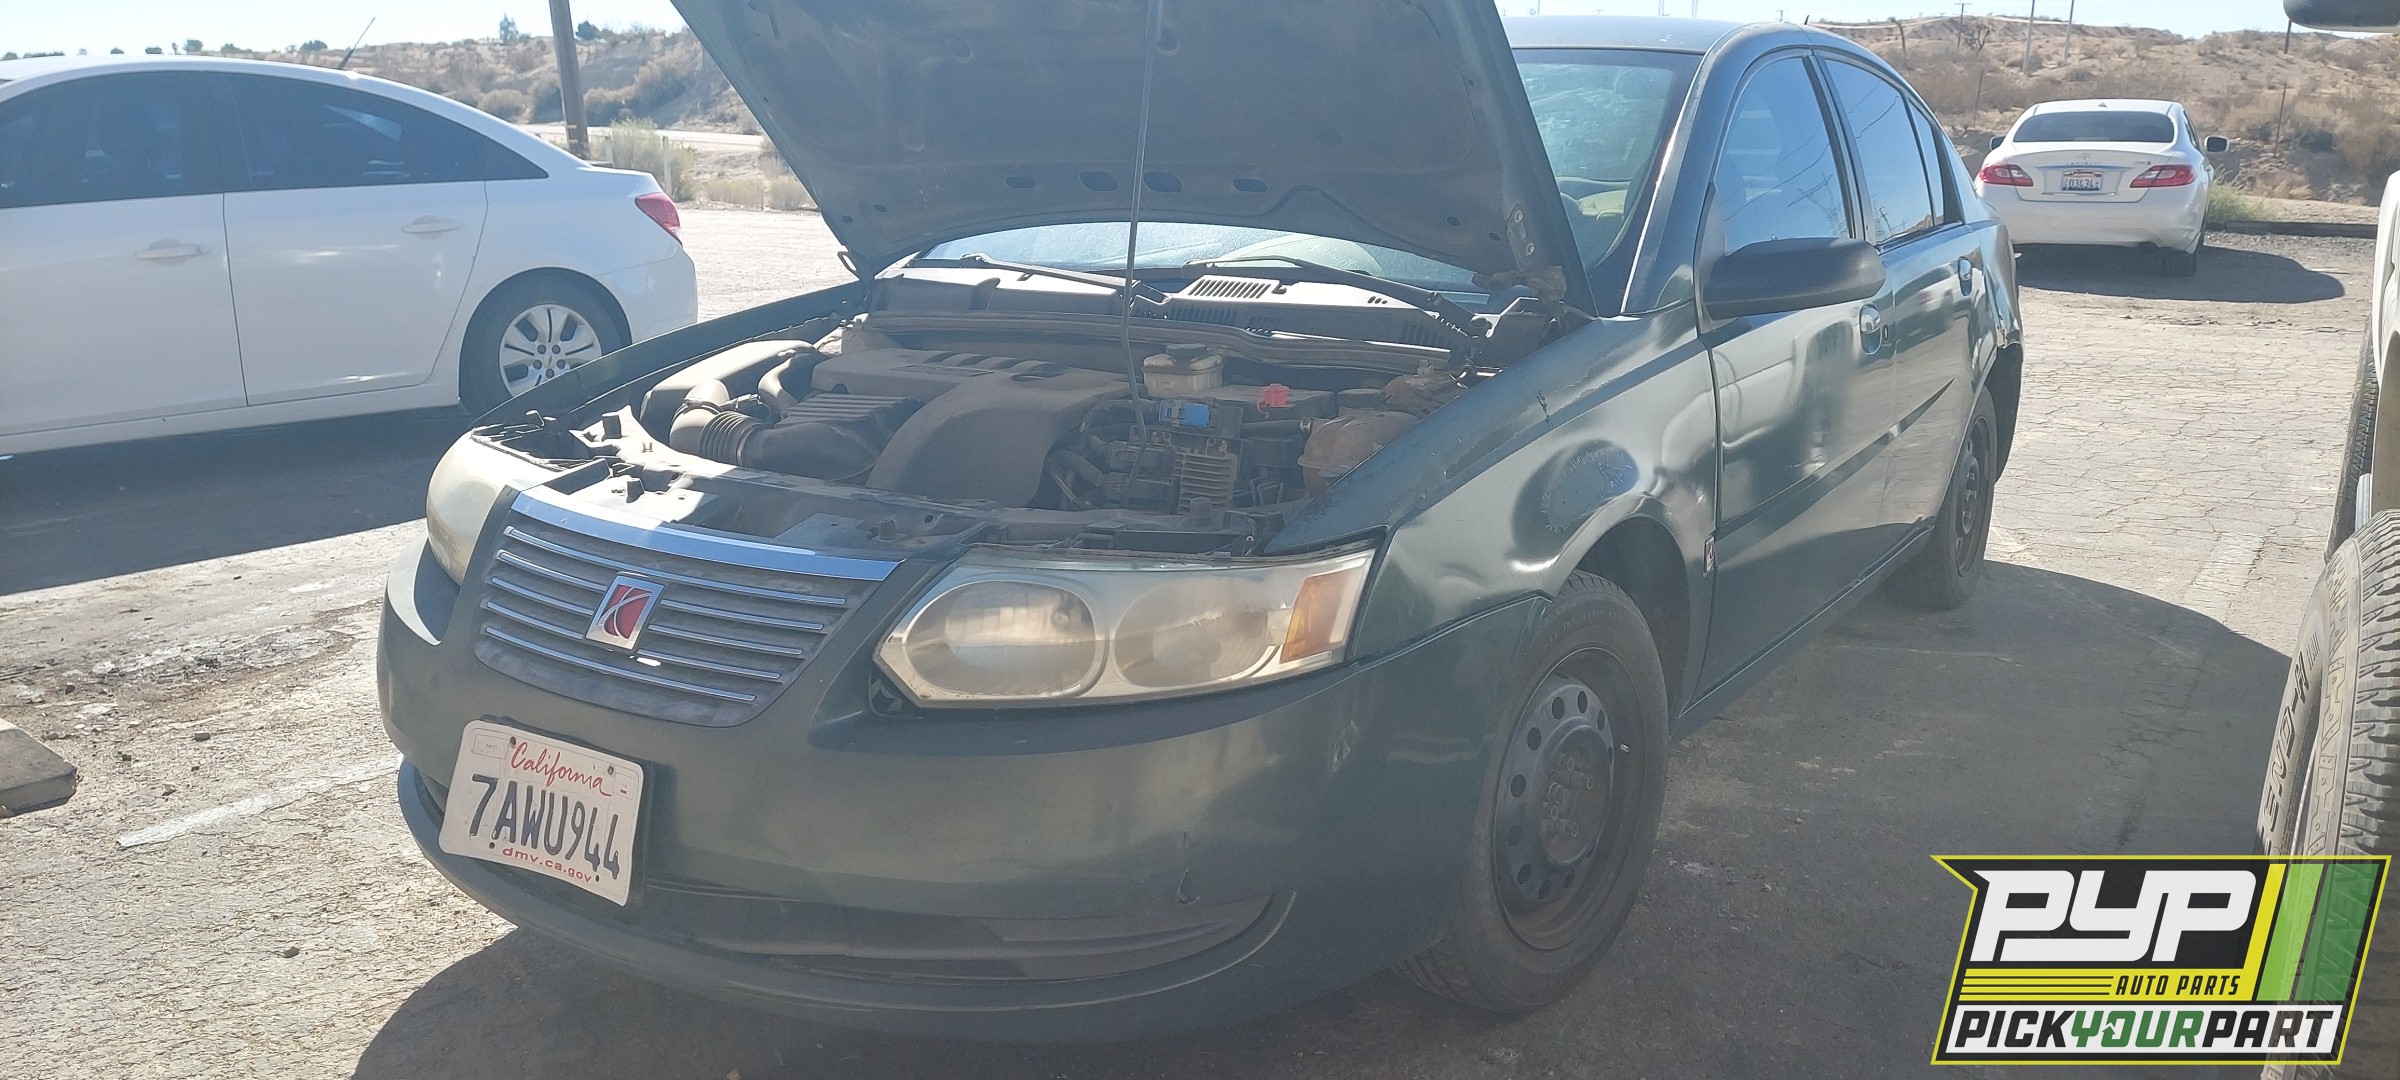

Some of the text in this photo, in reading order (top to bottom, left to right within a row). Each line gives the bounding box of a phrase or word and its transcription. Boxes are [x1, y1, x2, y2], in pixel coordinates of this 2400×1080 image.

[511, 741, 612, 797] California
[468, 773, 620, 880] 7AWU944
[502, 847, 592, 883] dmv.ca.gov
